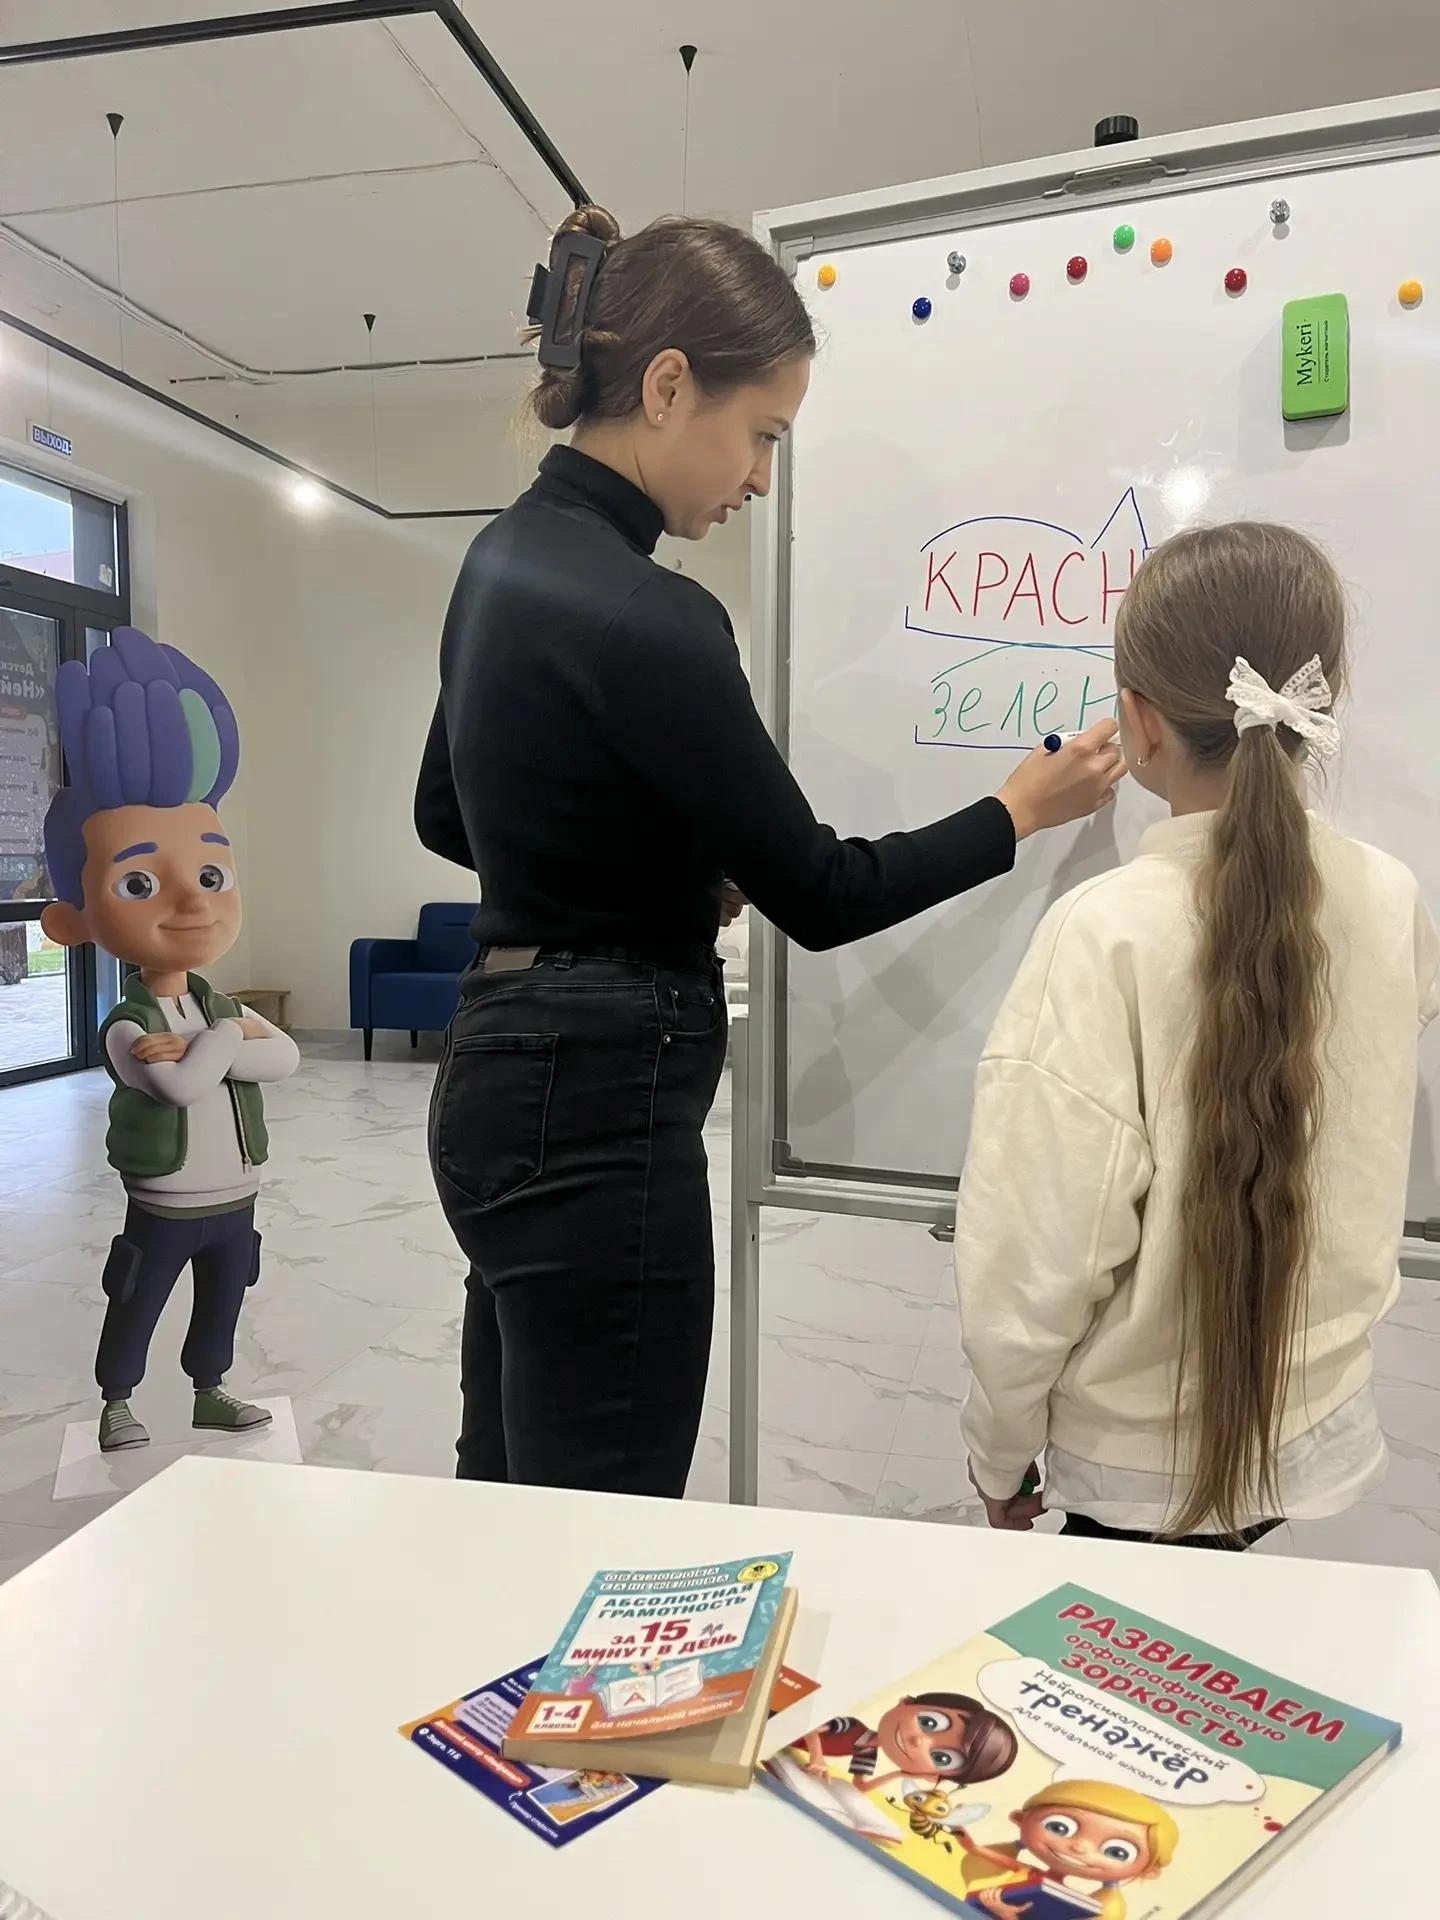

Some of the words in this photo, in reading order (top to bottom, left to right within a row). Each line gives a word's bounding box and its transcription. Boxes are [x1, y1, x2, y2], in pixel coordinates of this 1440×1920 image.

[1296, 323, 1316, 386] Mykeri
[34, 428, 70, 454] ВЫХОД
[598, 1597, 747, 1618] ГРАМОТНОСТЬ
[604, 1584, 753, 1607] АБСОЛЮТНАЯ
[571, 1646, 652, 1660] МИНУТ
[657, 1645, 672, 1655] В
[678, 1633, 738, 1655] ДЕНЬ
[611, 1635, 636, 1645] ЗА
[641, 1619, 691, 1643] 15
[1057, 1602, 1345, 1743] РАЗВИВАЕМ
[1065, 1635, 1287, 1742] орфографическую
[1013, 1706, 1041, 1721] для
[1044, 1721, 1118, 1760] начальной
[1117, 1760, 1168, 1787] школы
[1019, 1681, 1209, 1790] тренажёр
[1034, 1670, 1230, 1770] Нейропсихологический
